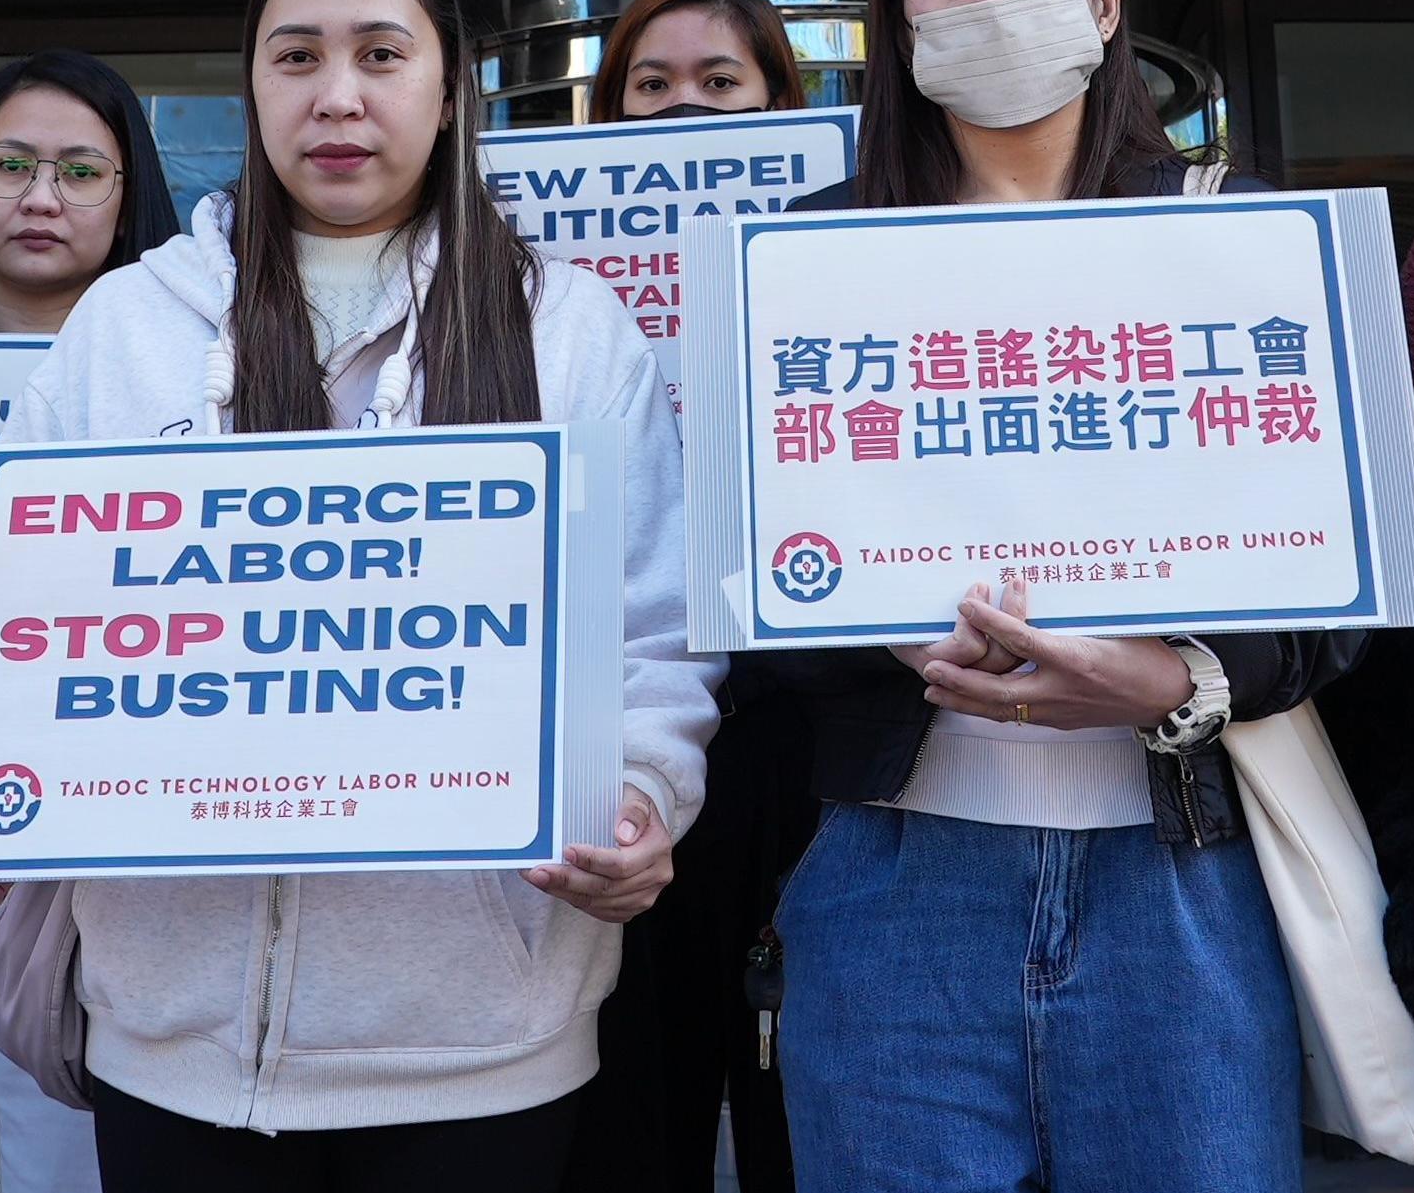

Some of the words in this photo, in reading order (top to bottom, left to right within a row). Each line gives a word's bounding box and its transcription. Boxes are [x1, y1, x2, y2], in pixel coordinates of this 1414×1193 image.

[486, 167, 586, 201] EW
[599, 154, 805, 196] TAIPEI
[771, 315, 1311, 397] 資方造謠染指工會
[773, 382, 1322, 464] 部會出面進行仲裁
[8, 491, 183, 536] END
[200, 479, 536, 529] FORCED
[112, 537, 422, 587] LABOR!
[859, 545, 953, 564] TAIDOC
[964, 538, 1135, 561] TECHNOLOGY
[1148, 534, 1230, 553] LABOR
[1242, 530, 1325, 549] UNION
[242, 603, 528, 655] UNION
[54, 665, 465, 720] BUSTING!
[60, 779, 149, 797] TAIDOC
[160, 775, 327, 794] TECHNOLOGY
[338, 773, 418, 791] LABOR
[429, 771, 511, 789] UNION
[189, 798, 359, 821] 泰博科技企業工會
